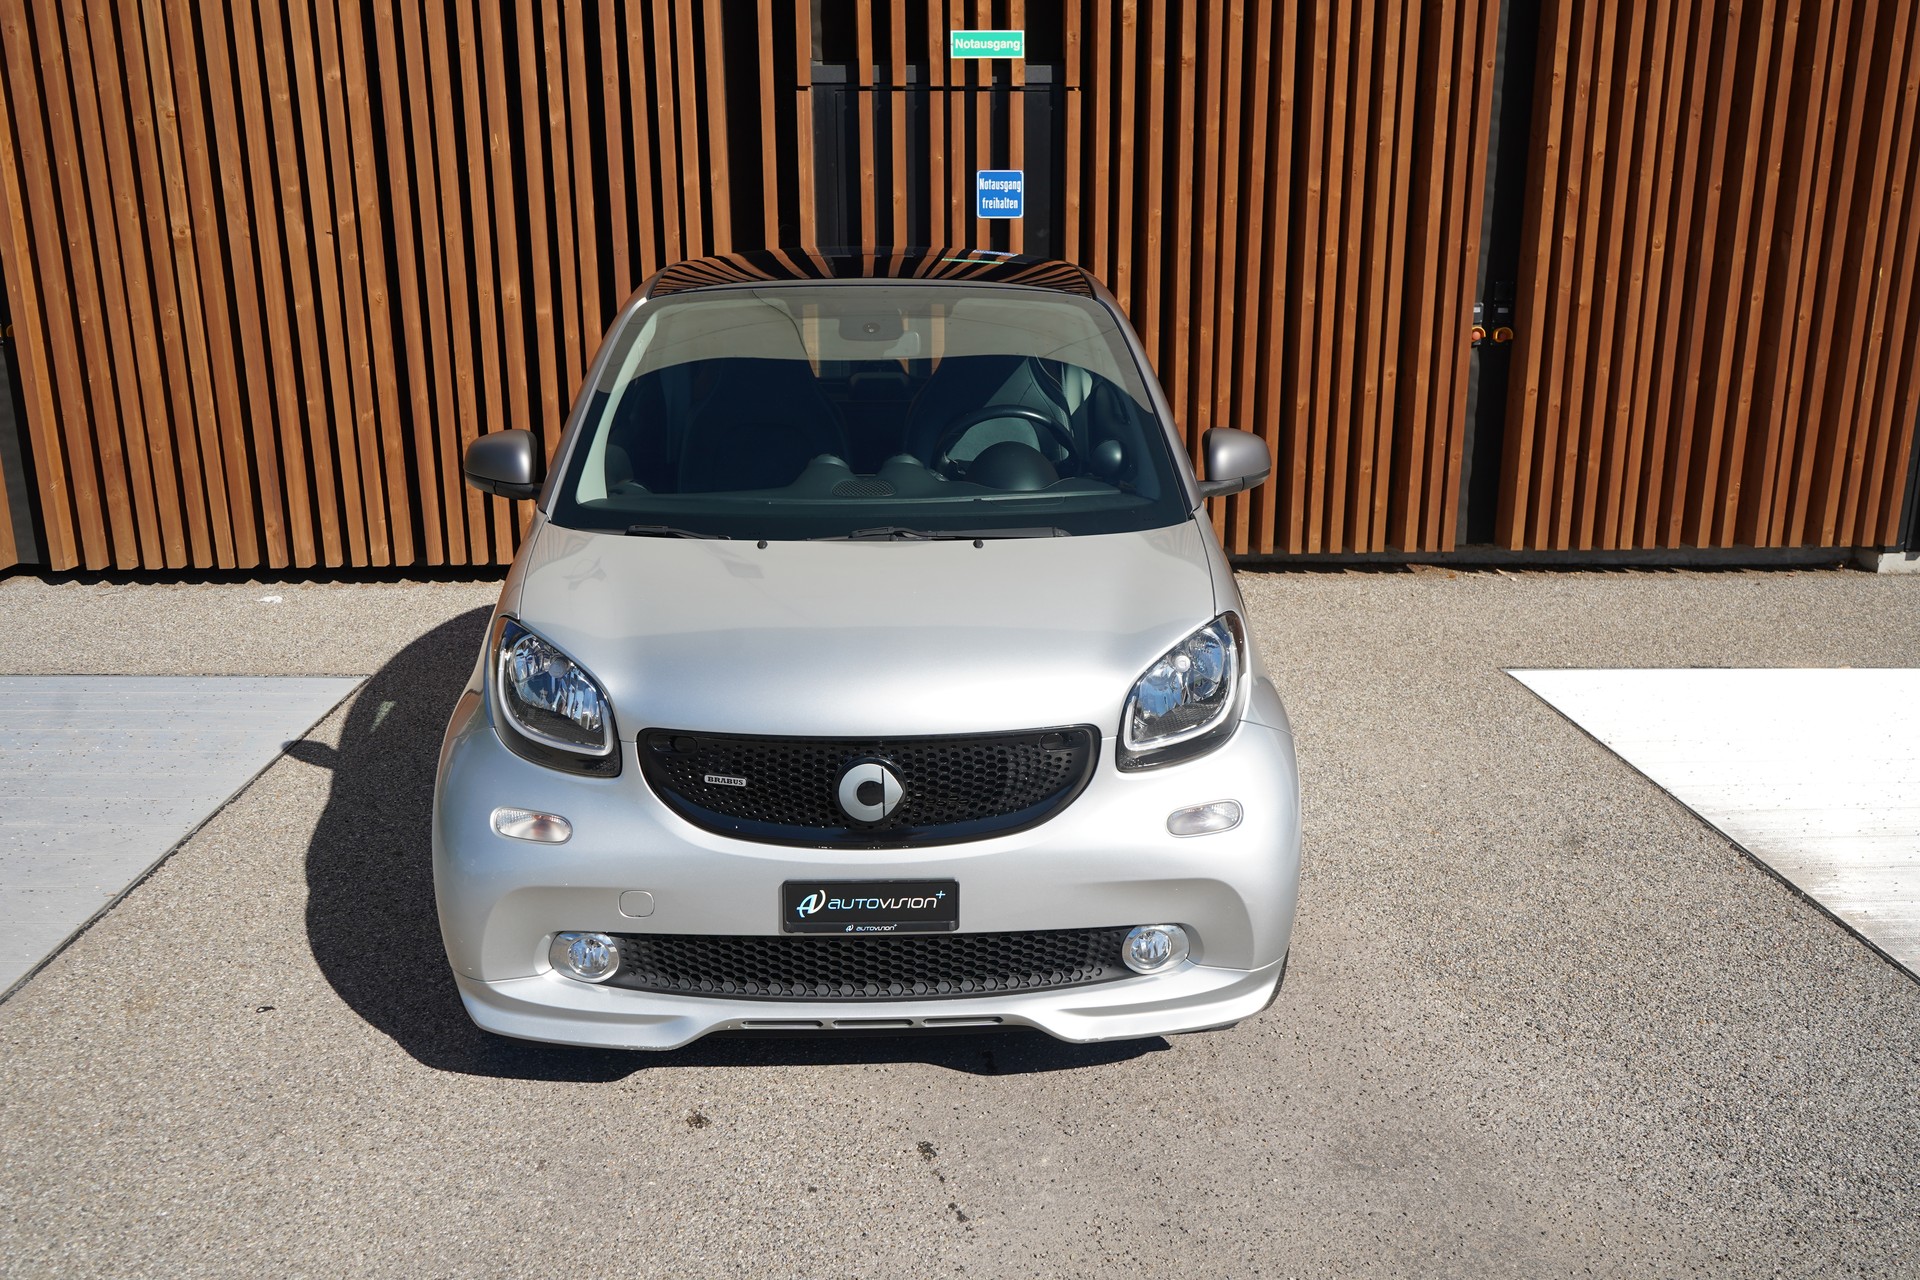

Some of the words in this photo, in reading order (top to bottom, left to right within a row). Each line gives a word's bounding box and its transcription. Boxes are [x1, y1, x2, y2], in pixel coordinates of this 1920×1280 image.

[955, 38, 1020, 51] Notausgang
[979, 178, 1021, 192] Notausgang
[982, 197, 1018, 209] freihalten
[707, 776, 744, 786] BRABUS
